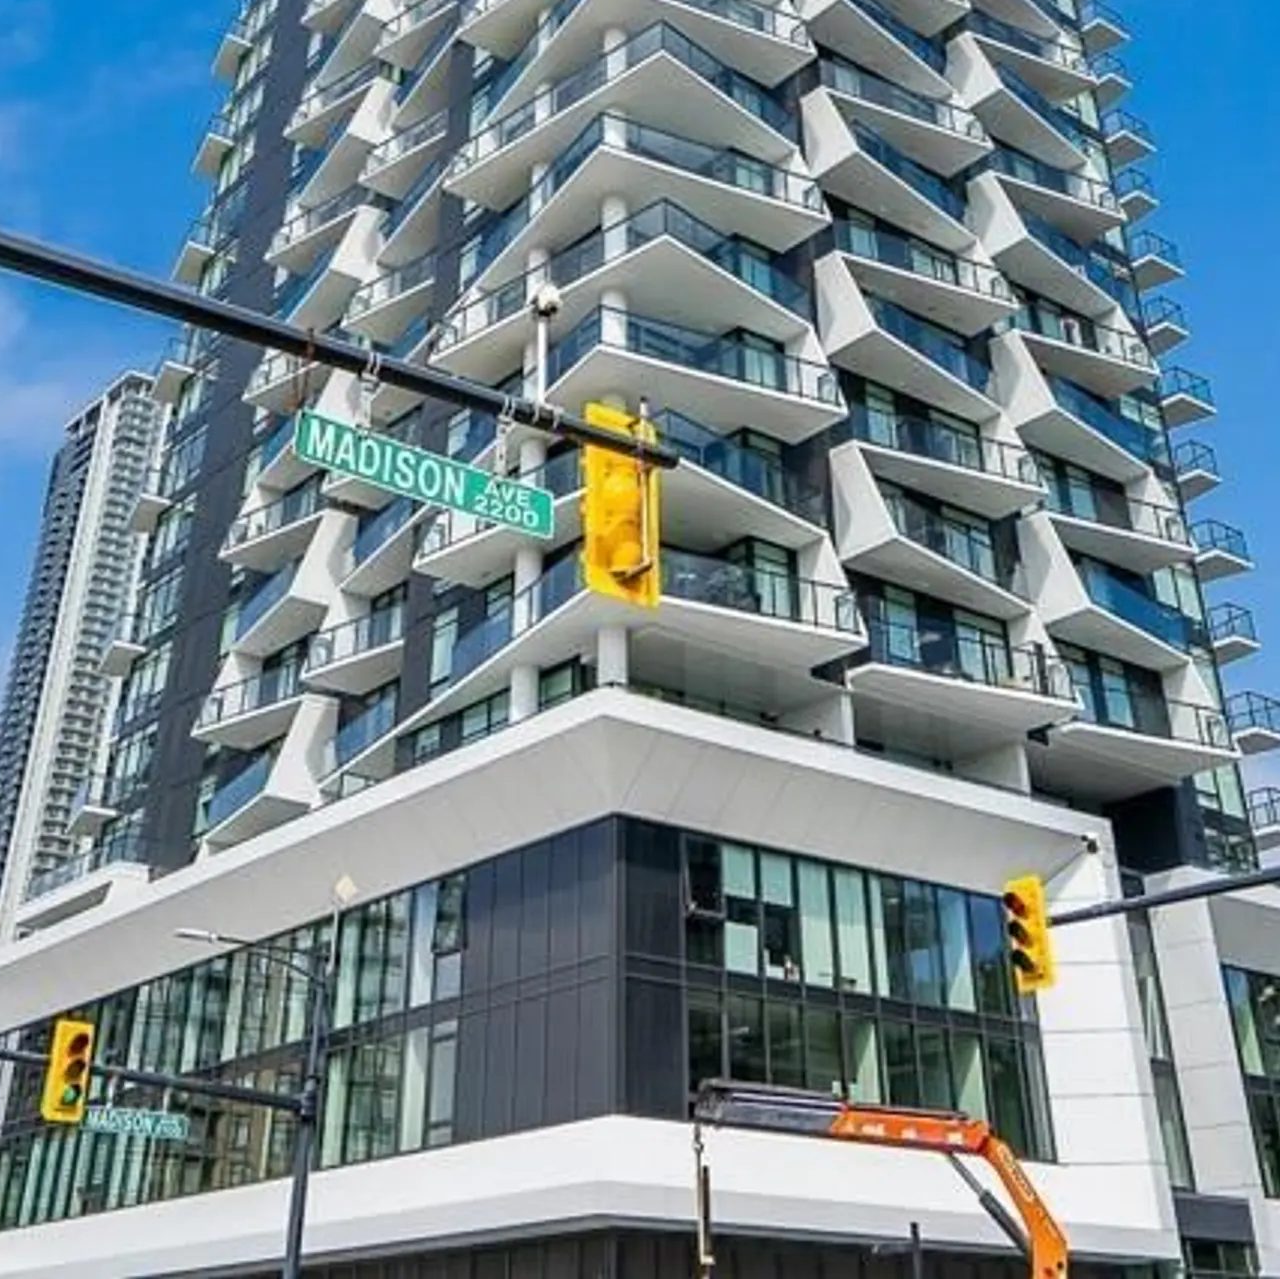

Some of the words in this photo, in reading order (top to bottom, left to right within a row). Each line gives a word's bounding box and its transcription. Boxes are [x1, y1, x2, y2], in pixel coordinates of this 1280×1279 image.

[307, 420, 465, 505] MADISON
[483, 482, 531, 507] AVE
[474, 495, 539, 527] 2200
